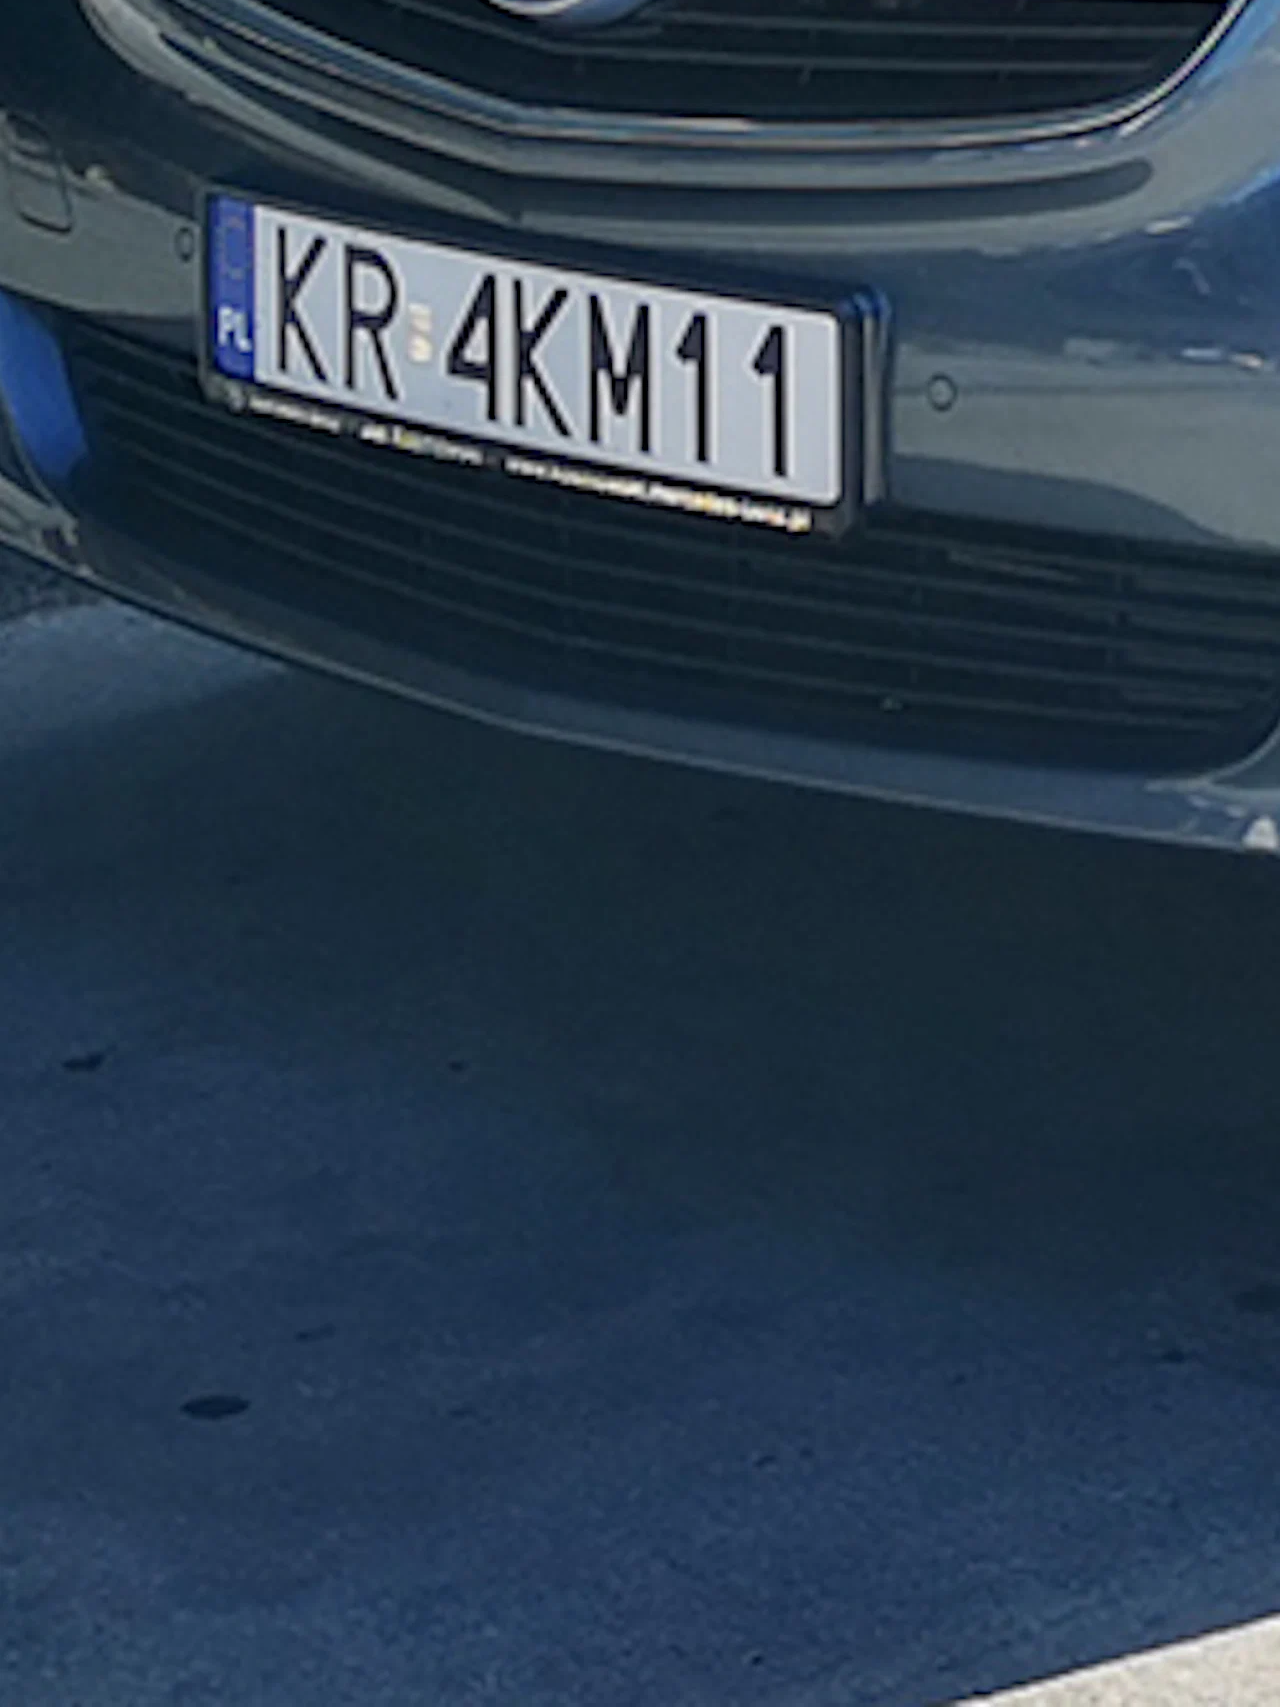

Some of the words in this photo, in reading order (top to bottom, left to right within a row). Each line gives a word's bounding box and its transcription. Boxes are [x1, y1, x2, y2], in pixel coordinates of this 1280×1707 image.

[217, 305, 253, 353] PL
[276, 226, 399, 401] KR
[446, 273, 789, 478] 4KM11
